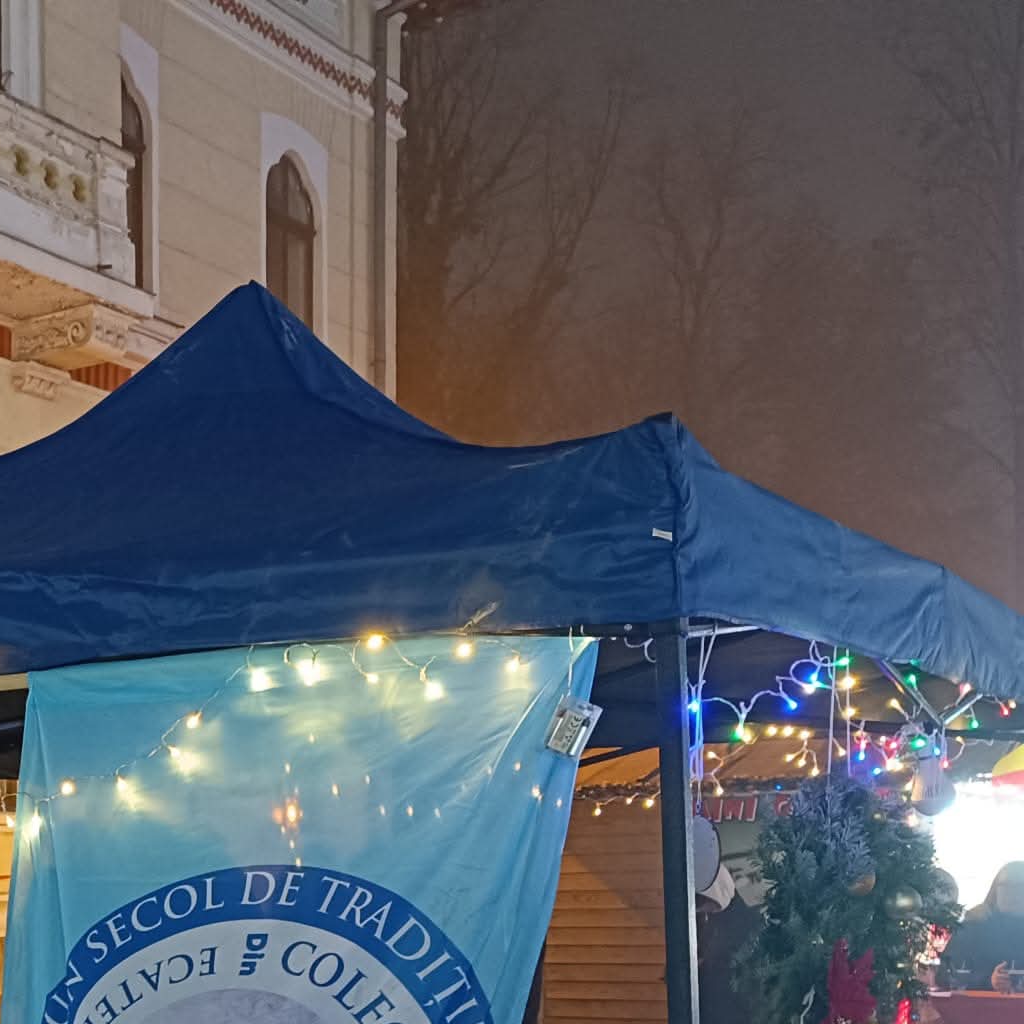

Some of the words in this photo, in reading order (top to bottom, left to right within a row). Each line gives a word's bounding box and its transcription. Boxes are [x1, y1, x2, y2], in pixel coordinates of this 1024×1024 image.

[85, 876, 225, 964] SECOL
[240, 870, 305, 907] DE
[239, 933, 269, 977] Din
